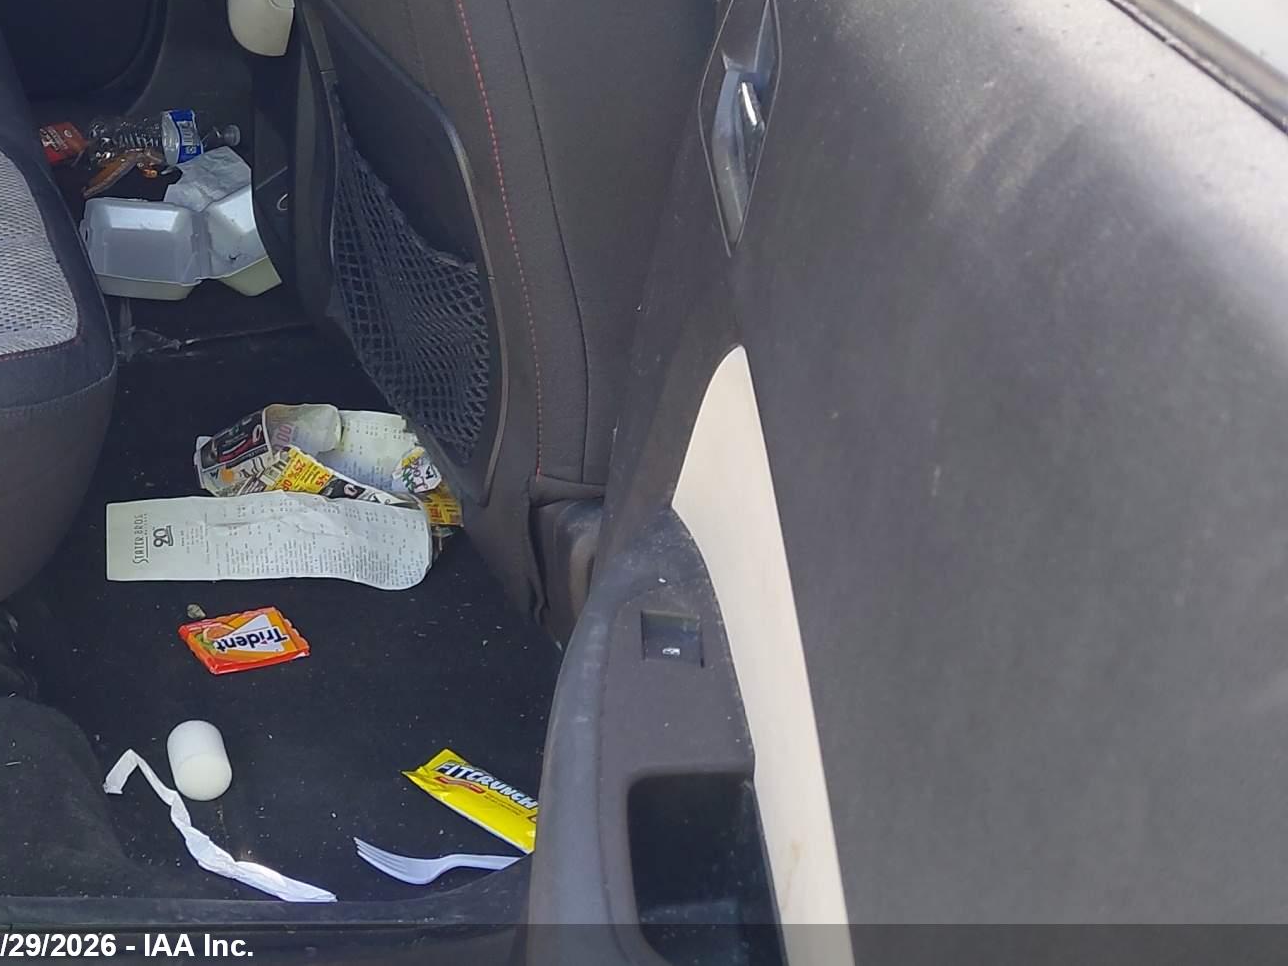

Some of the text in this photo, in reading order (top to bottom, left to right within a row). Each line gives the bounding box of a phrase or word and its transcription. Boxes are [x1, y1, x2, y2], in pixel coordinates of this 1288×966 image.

[132, 536, 150, 564] STATER
[215, 627, 288, 652] Trident
[434, 761, 539, 810] FITCRUNCH
